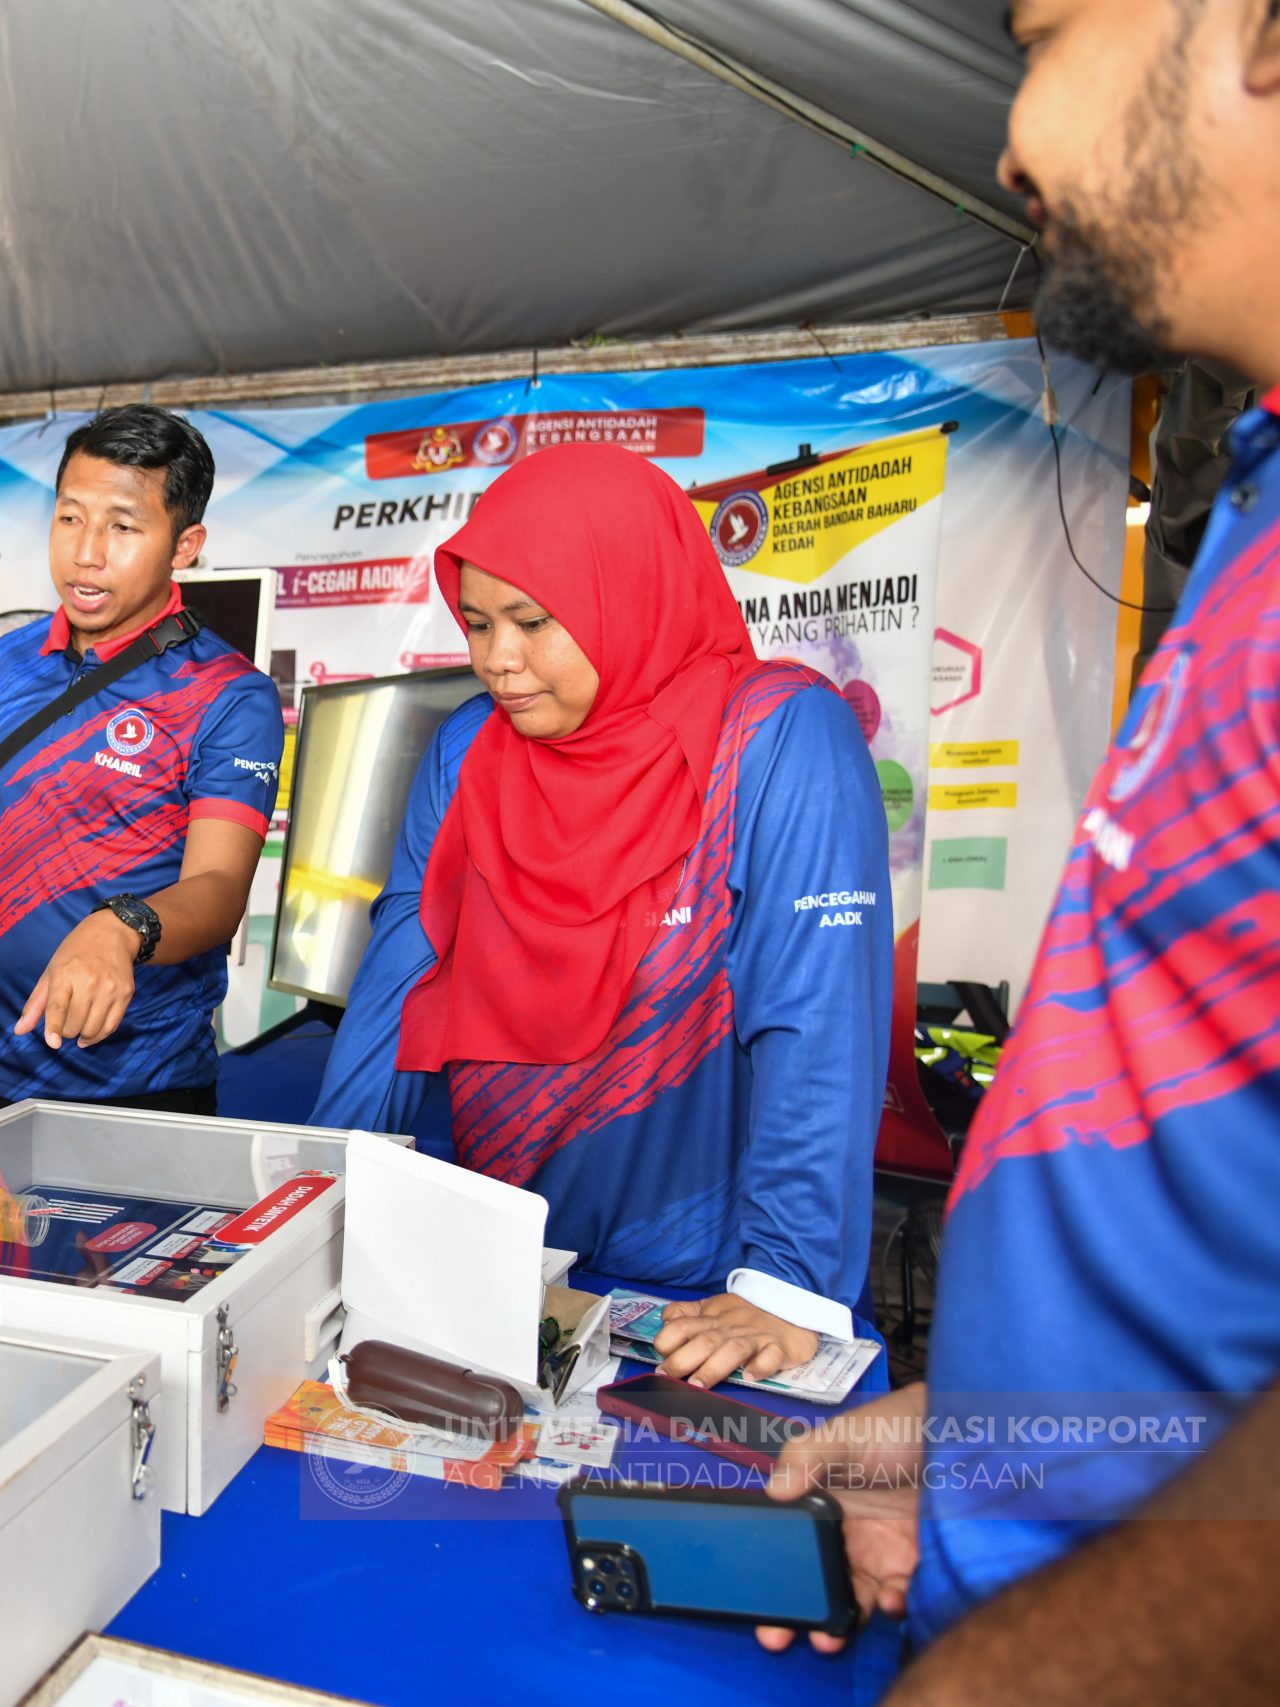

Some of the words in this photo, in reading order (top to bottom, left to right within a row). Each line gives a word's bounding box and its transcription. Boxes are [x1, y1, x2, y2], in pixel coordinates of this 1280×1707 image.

[526, 429, 657, 444] KEBANGSAAN
[528, 418, 575, 432] AGENSI
[576, 415, 657, 430] ANTIDADAH
[774, 476, 825, 501] AGENSI
[828, 456, 913, 488] ANTIDADAH
[773, 487, 867, 521] KEBANGSAAN
[773, 516, 821, 538] DAERAH
[824, 508, 864, 529] BANDAR
[867, 498, 918, 520] BAHARU
[772, 536, 815, 554] KEDAH
[778, 588, 834, 621] ANDA
[836, 574, 918, 613] MENJADI
[758, 619, 819, 647] YANG
[824, 607, 903, 641] PRIHATIN
[911, 605, 920, 629] ?
[94, 751, 143, 779] KHAIRIL
[794, 890, 876, 913] PENCEGAHAN
[819, 911, 863, 928] AADK
[278, 1185, 314, 1207] DADAH
[242, 1203, 288, 1232] SINTETIK
